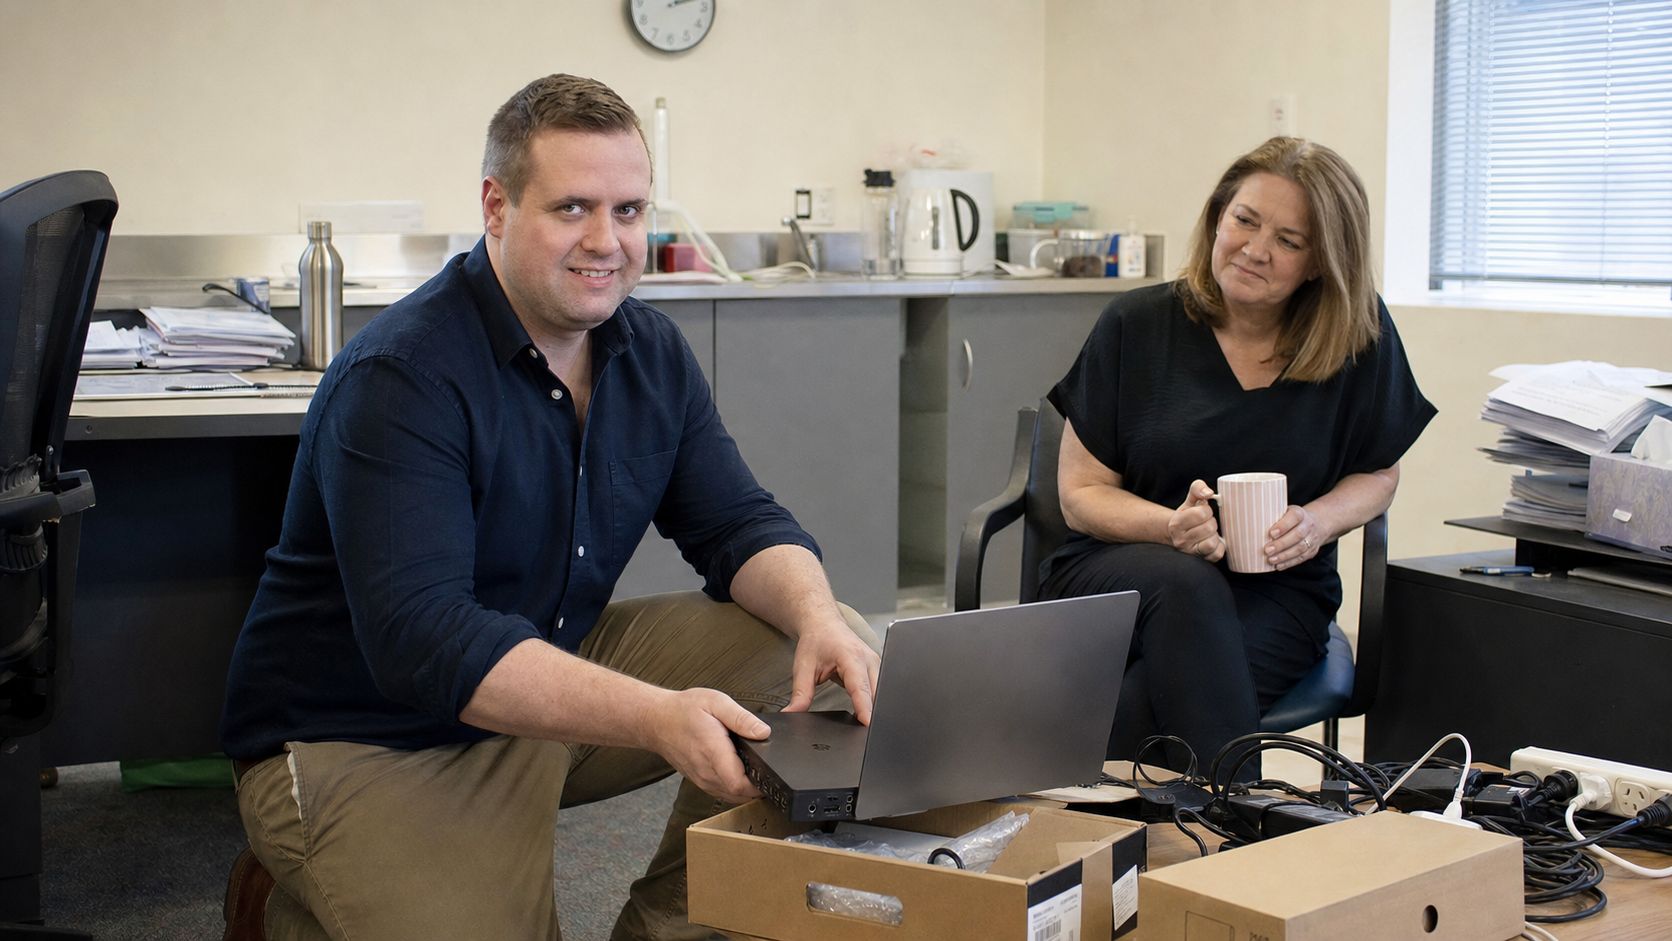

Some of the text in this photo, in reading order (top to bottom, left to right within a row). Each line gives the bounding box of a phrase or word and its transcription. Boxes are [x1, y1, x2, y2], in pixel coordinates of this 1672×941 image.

[639, 14, 648, 26] 8
[651, 27, 659, 41] 7
[666, 33, 675, 46] 6
